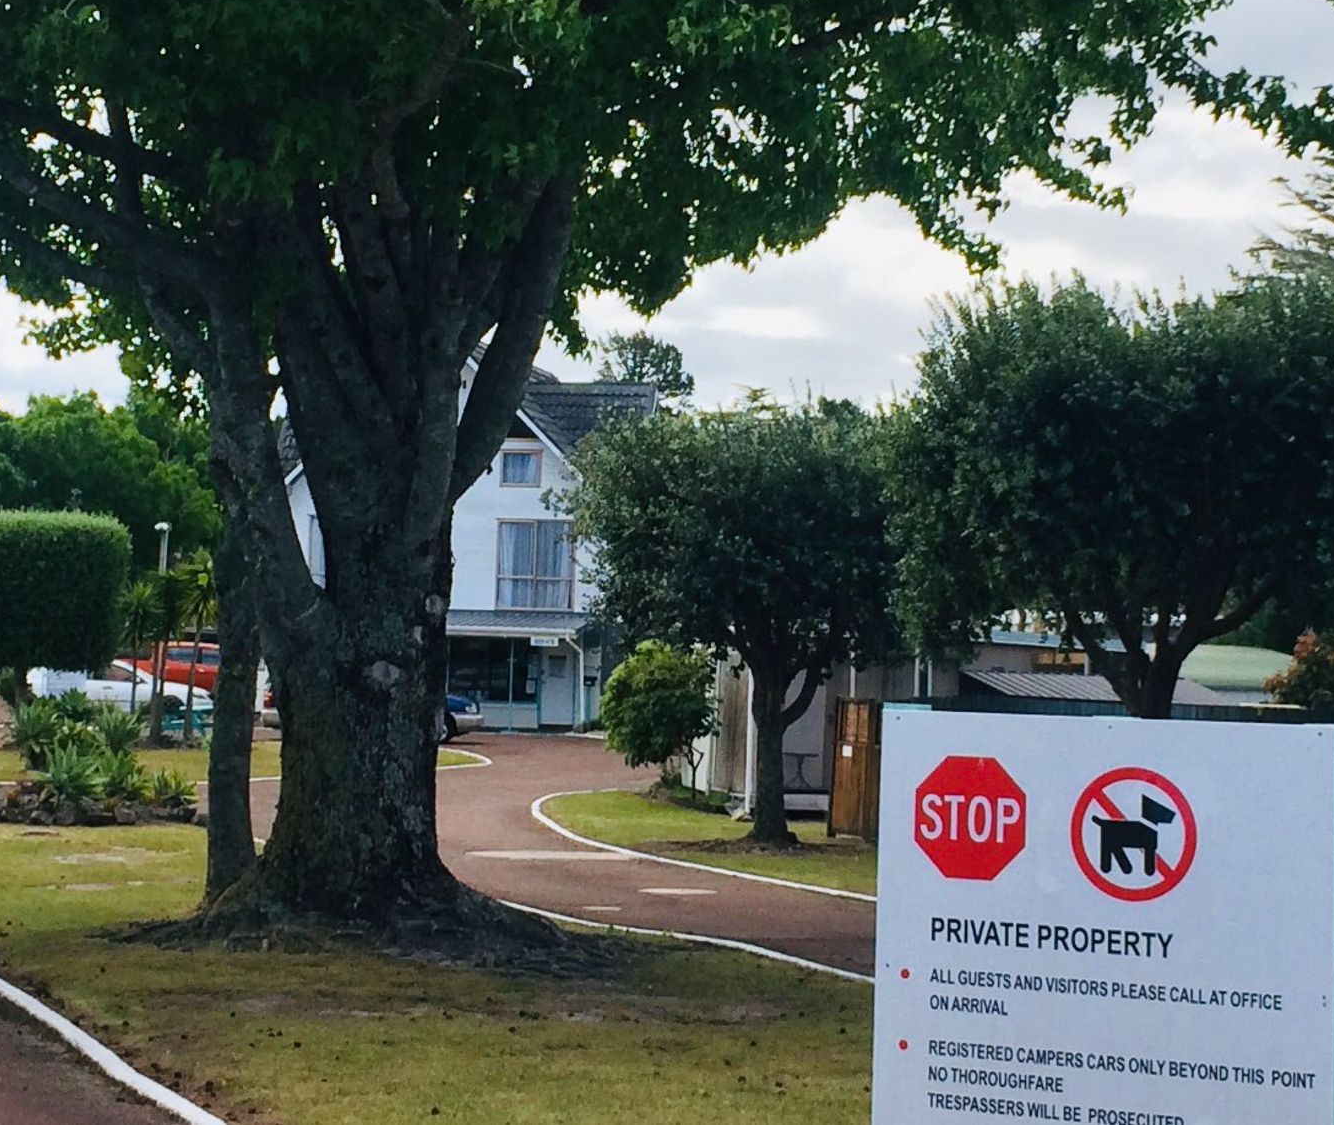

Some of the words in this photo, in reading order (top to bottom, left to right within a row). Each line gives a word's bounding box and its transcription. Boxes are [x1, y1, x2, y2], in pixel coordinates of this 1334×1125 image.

[919, 793, 1021, 843] STOP
[931, 917, 1029, 948] PRIVATE
[1037, 924, 1173, 958] PROPERTY
[929, 968, 955, 985] ALL
[958, 970, 1012, 989] GUESTS
[1014, 975, 1043, 992] AND
[1046, 976, 1108, 997] VISITORS
[1112, 982, 1166, 1002] PLEASE
[1170, 986, 1207, 1005] CALL
[1209, 990, 1227, 1006] AT
[1230, 991, 1282, 1011] OFFICE
[929, 994, 949, 1011] ON
[951, 996, 1008, 1016] ARRIVAL
[928, 1040, 1013, 1062] REGISTERED
[1017, 1047, 1084, 1069] CAMPERS
[1087, 1053, 1126, 1072] CARS
[1128, 1057, 1166, 1075] ONLY
[1169, 1061, 1229, 1082] BEYOND
[1232, 1066, 1264, 1085] THIS
[1271, 1070, 1316, 1089] POINT
[928, 1066, 948, 1082] NO
[951, 1068, 1064, 1093] THOROUGHFARE
[927, 1092, 1024, 1117] TRESPASSERS
[1027, 1101, 1060, 1121] WILL
[1063, 1105, 1082, 1123] BE
[1088, 1108, 1185, 1125] PROSECUTED
